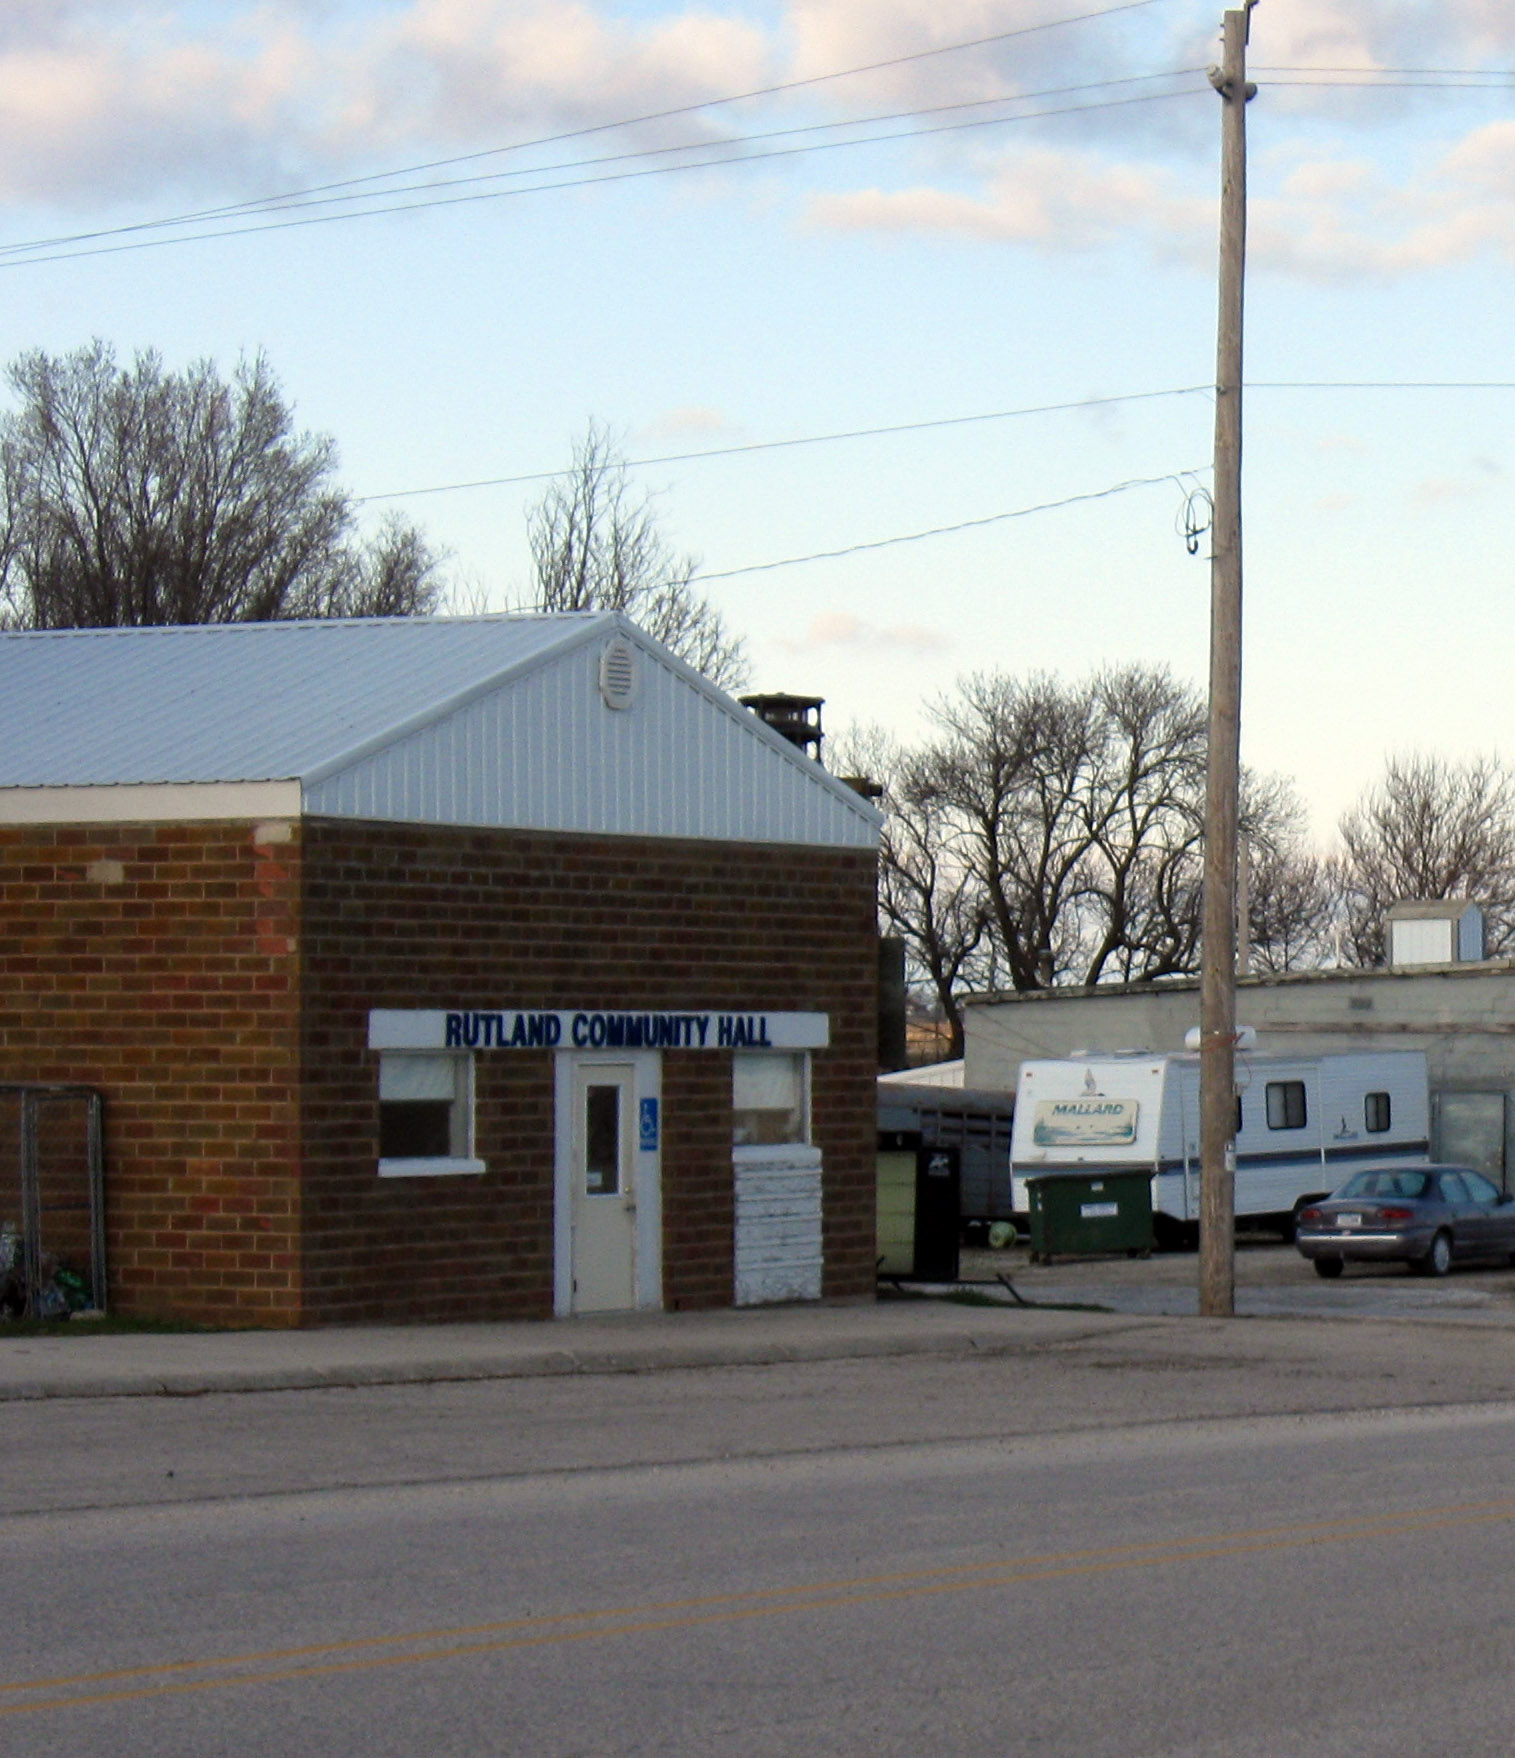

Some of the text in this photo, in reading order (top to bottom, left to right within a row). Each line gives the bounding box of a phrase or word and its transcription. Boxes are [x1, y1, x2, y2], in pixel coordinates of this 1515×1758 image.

[445, 1012, 772, 1047] RUTLAND COMMUNITY HALL
[1052, 1103, 1124, 1115] MALLARD
